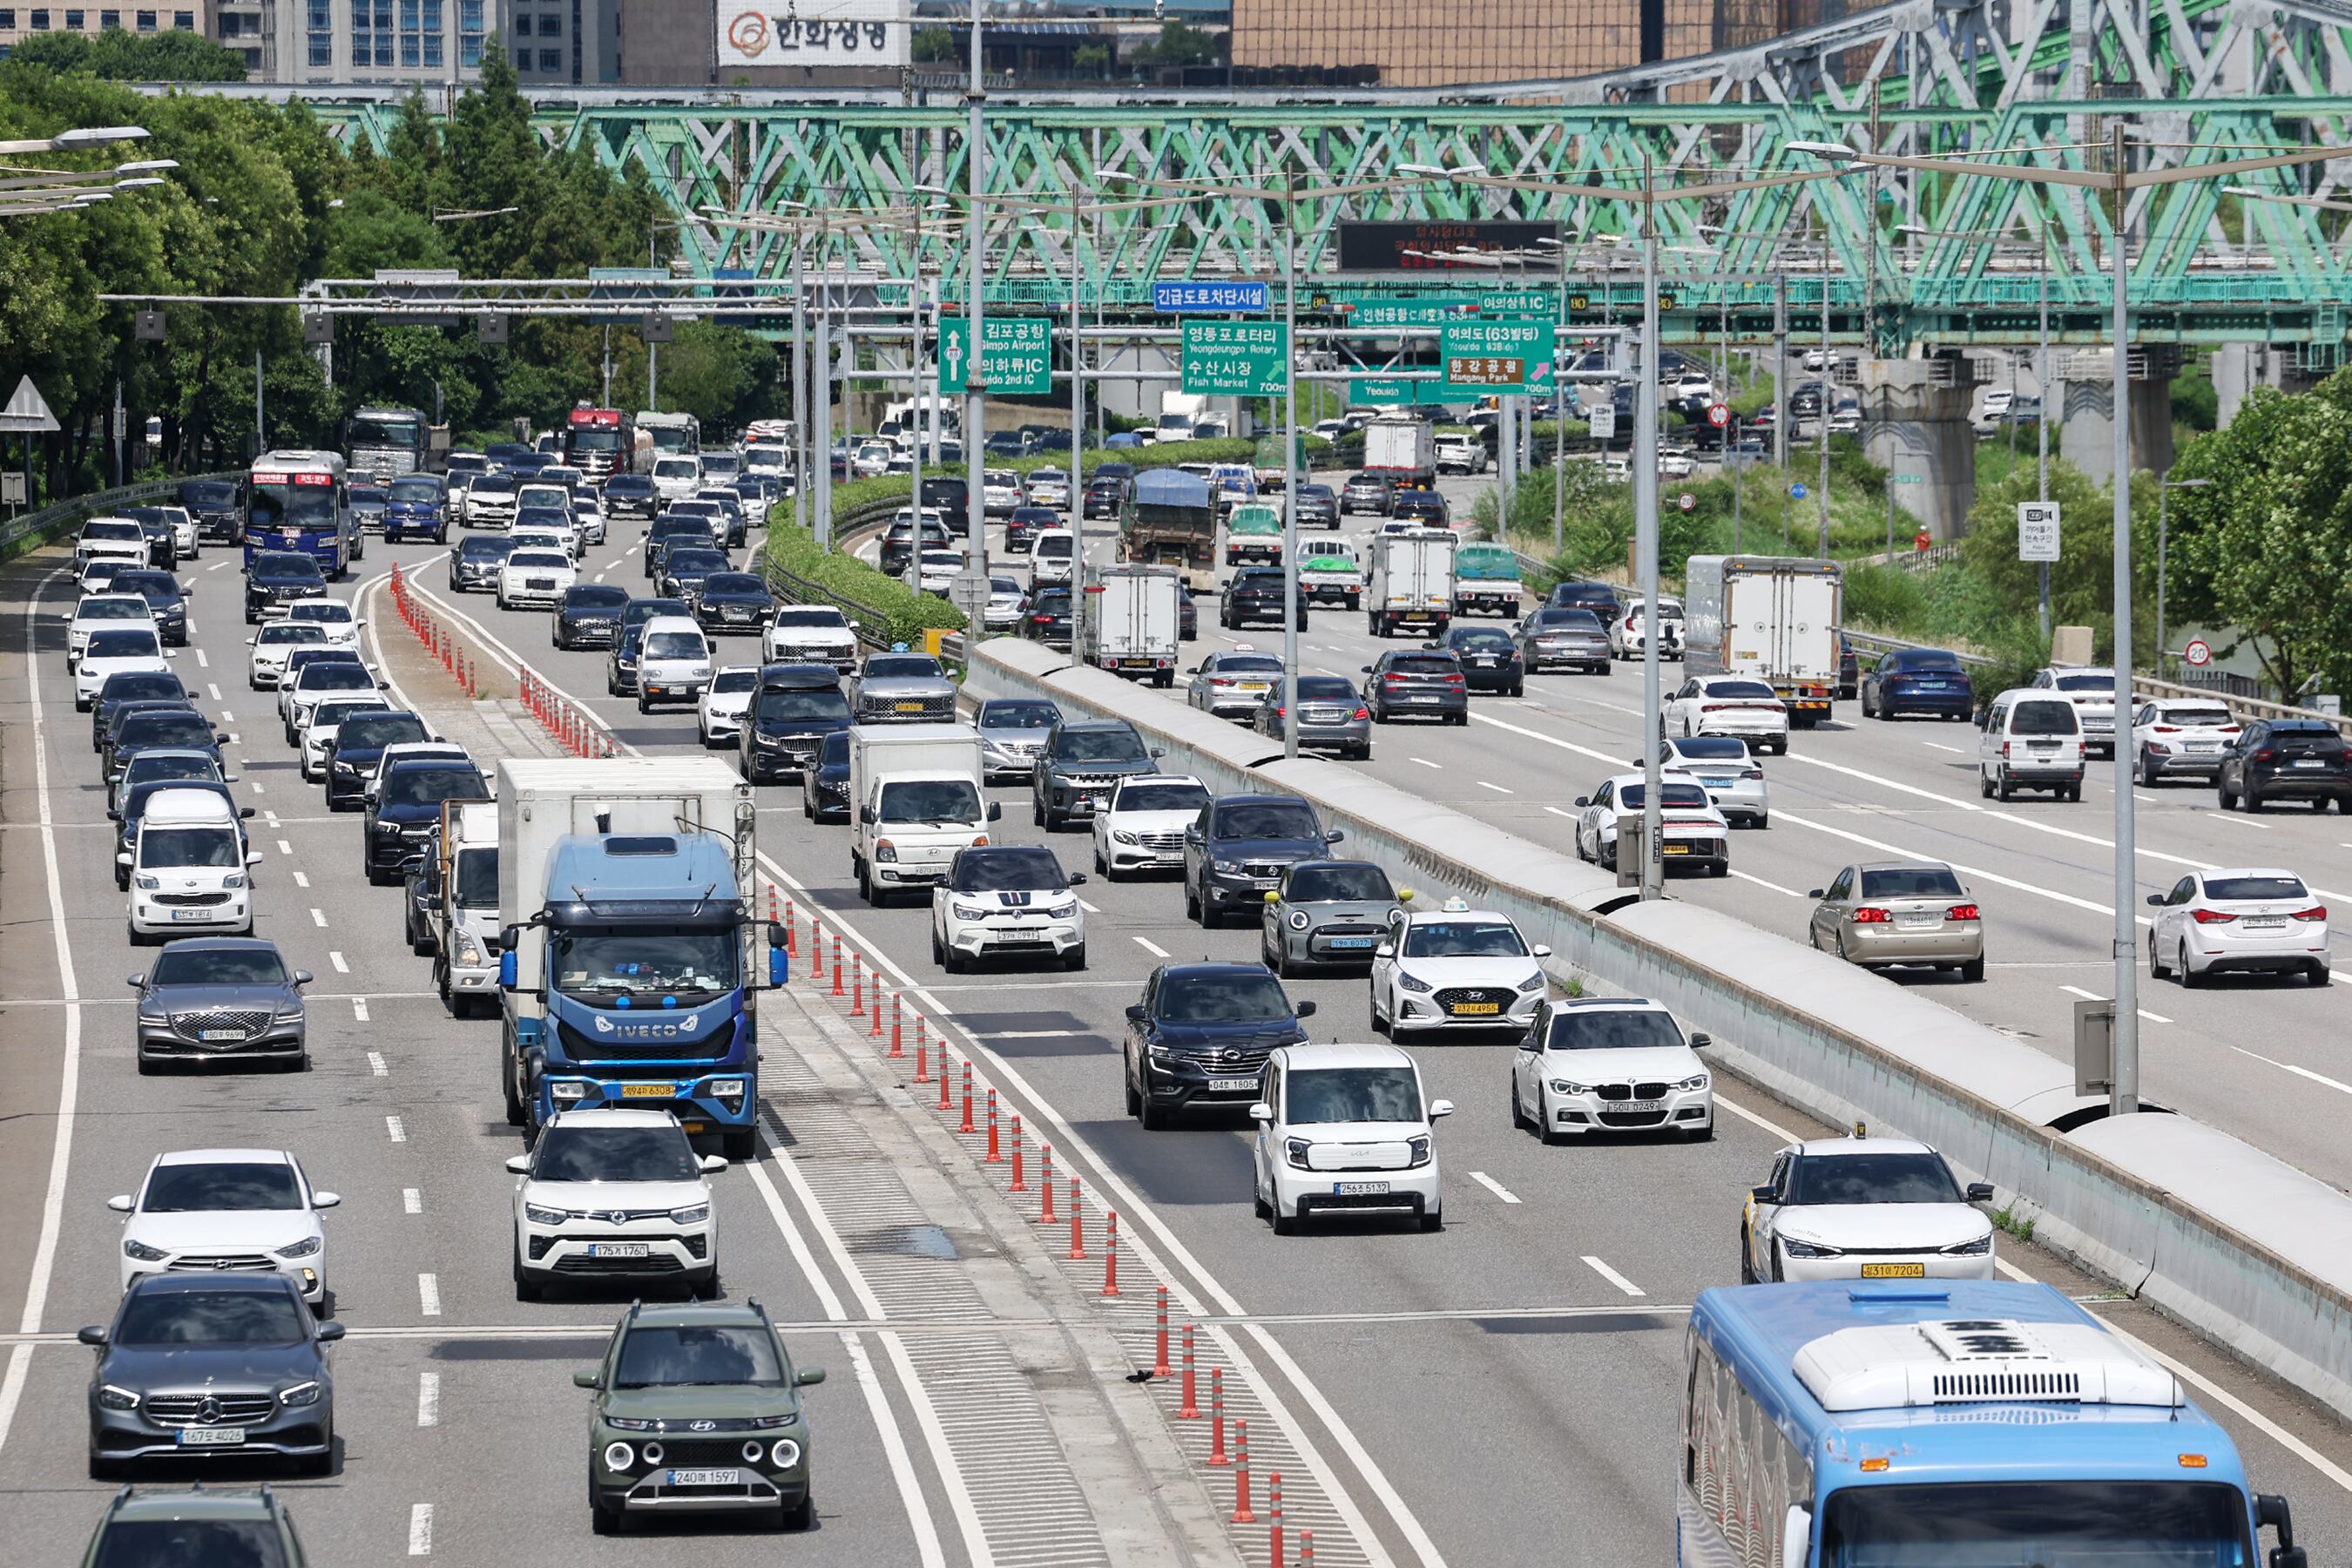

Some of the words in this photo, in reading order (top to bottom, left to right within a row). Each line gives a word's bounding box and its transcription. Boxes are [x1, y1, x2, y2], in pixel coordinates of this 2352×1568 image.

[776, 20, 886, 51] 한화생명
[1157, 289, 1262, 305] 긴급도로차단시설
[1363, 308, 1407, 322] 인천공항
[986, 323, 1044, 339] 김포공항
[1189, 327, 1277, 343] 영등포로터리
[1448, 327, 1538, 341] 여의도(63빌딩)
[1012, 340, 1044, 352] Airport
[1189, 344, 1246, 355] Yeongdeungpo
[1250, 344, 1277, 355] Rotary
[967, 358, 1044, 373] 의하류IC
[1188, 360, 1252, 376] 수산시장
[1451, 360, 1517, 374] 한강공원
[1005, 375, 1022, 385] 2nd
[1024, 375, 1035, 385] IC
[1188, 377, 1209, 387] Fish
[1213, 377, 1248, 389] Market
[1450, 373, 1486, 383] Hangang
[1489, 373, 1509, 382] Park
[1364, 386, 1399, 396] Yeouido
[1524, 384, 1551, 393] 700m
[2191, 648, 2205, 659] 20
[226, 1031, 244, 1039] 9699
[617, 1024, 678, 1038] IVECO
[1233, 1079, 1254, 1089] 1805
[1633, 1102, 1655, 1112] 0249
[1366, 1183, 1387, 1193] 5132
[624, 1246, 645, 1256] 1760
[1894, 1265, 1919, 1275] 7204
[215, 1430, 243, 1442] 4026
[710, 1470, 737, 1483] 1597
